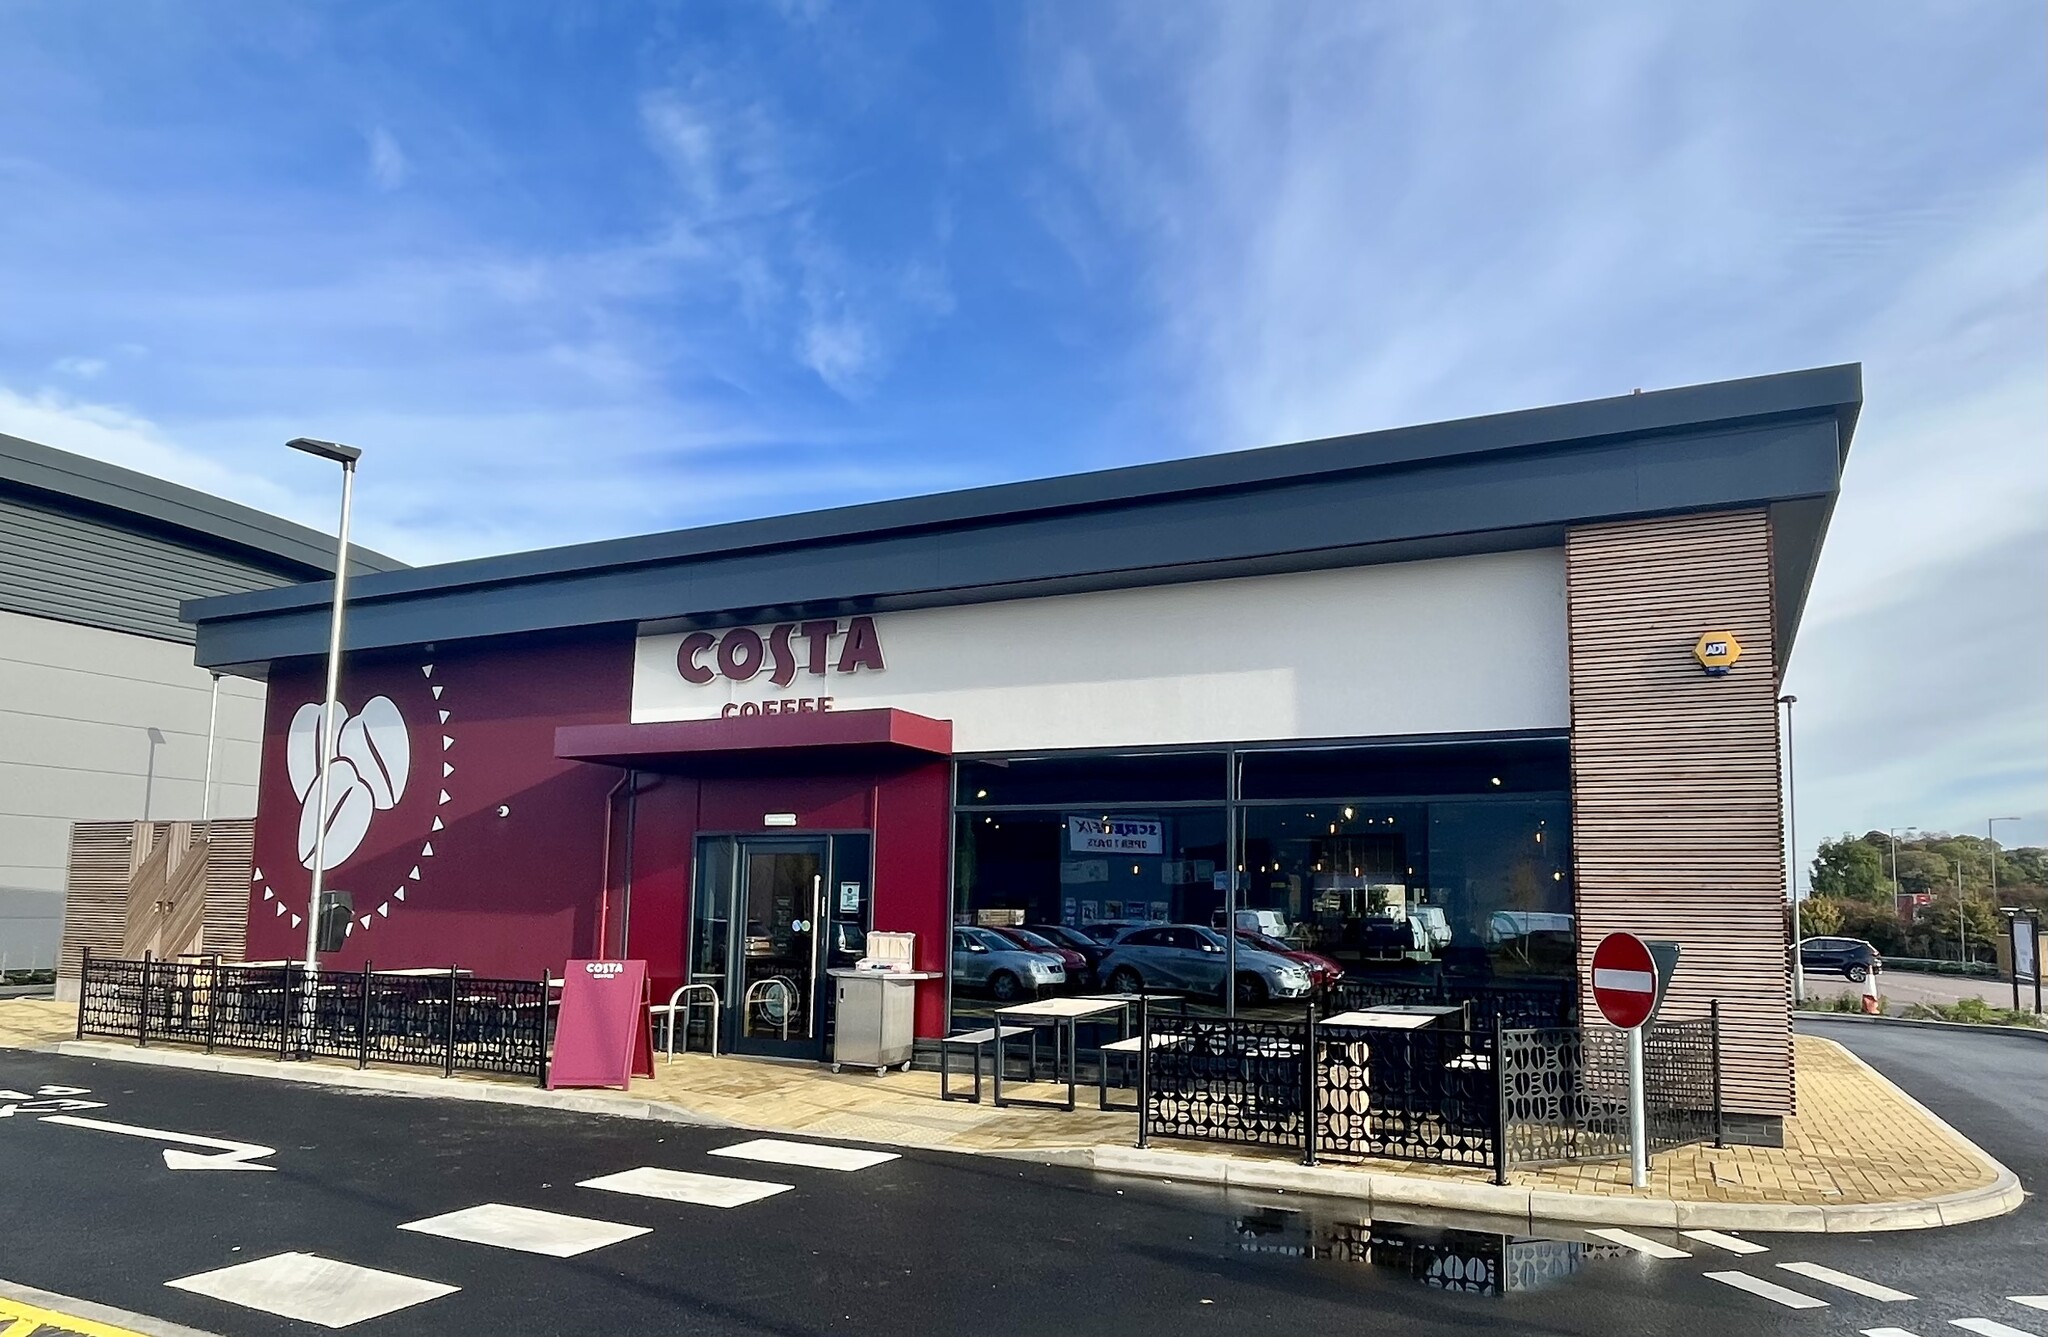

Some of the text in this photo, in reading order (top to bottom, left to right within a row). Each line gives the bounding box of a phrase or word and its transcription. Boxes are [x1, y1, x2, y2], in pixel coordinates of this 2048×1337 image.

[677, 616, 886, 688] COSTA
[1705, 643, 1727, 655] ADT
[586, 963, 623, 974] COSTA
